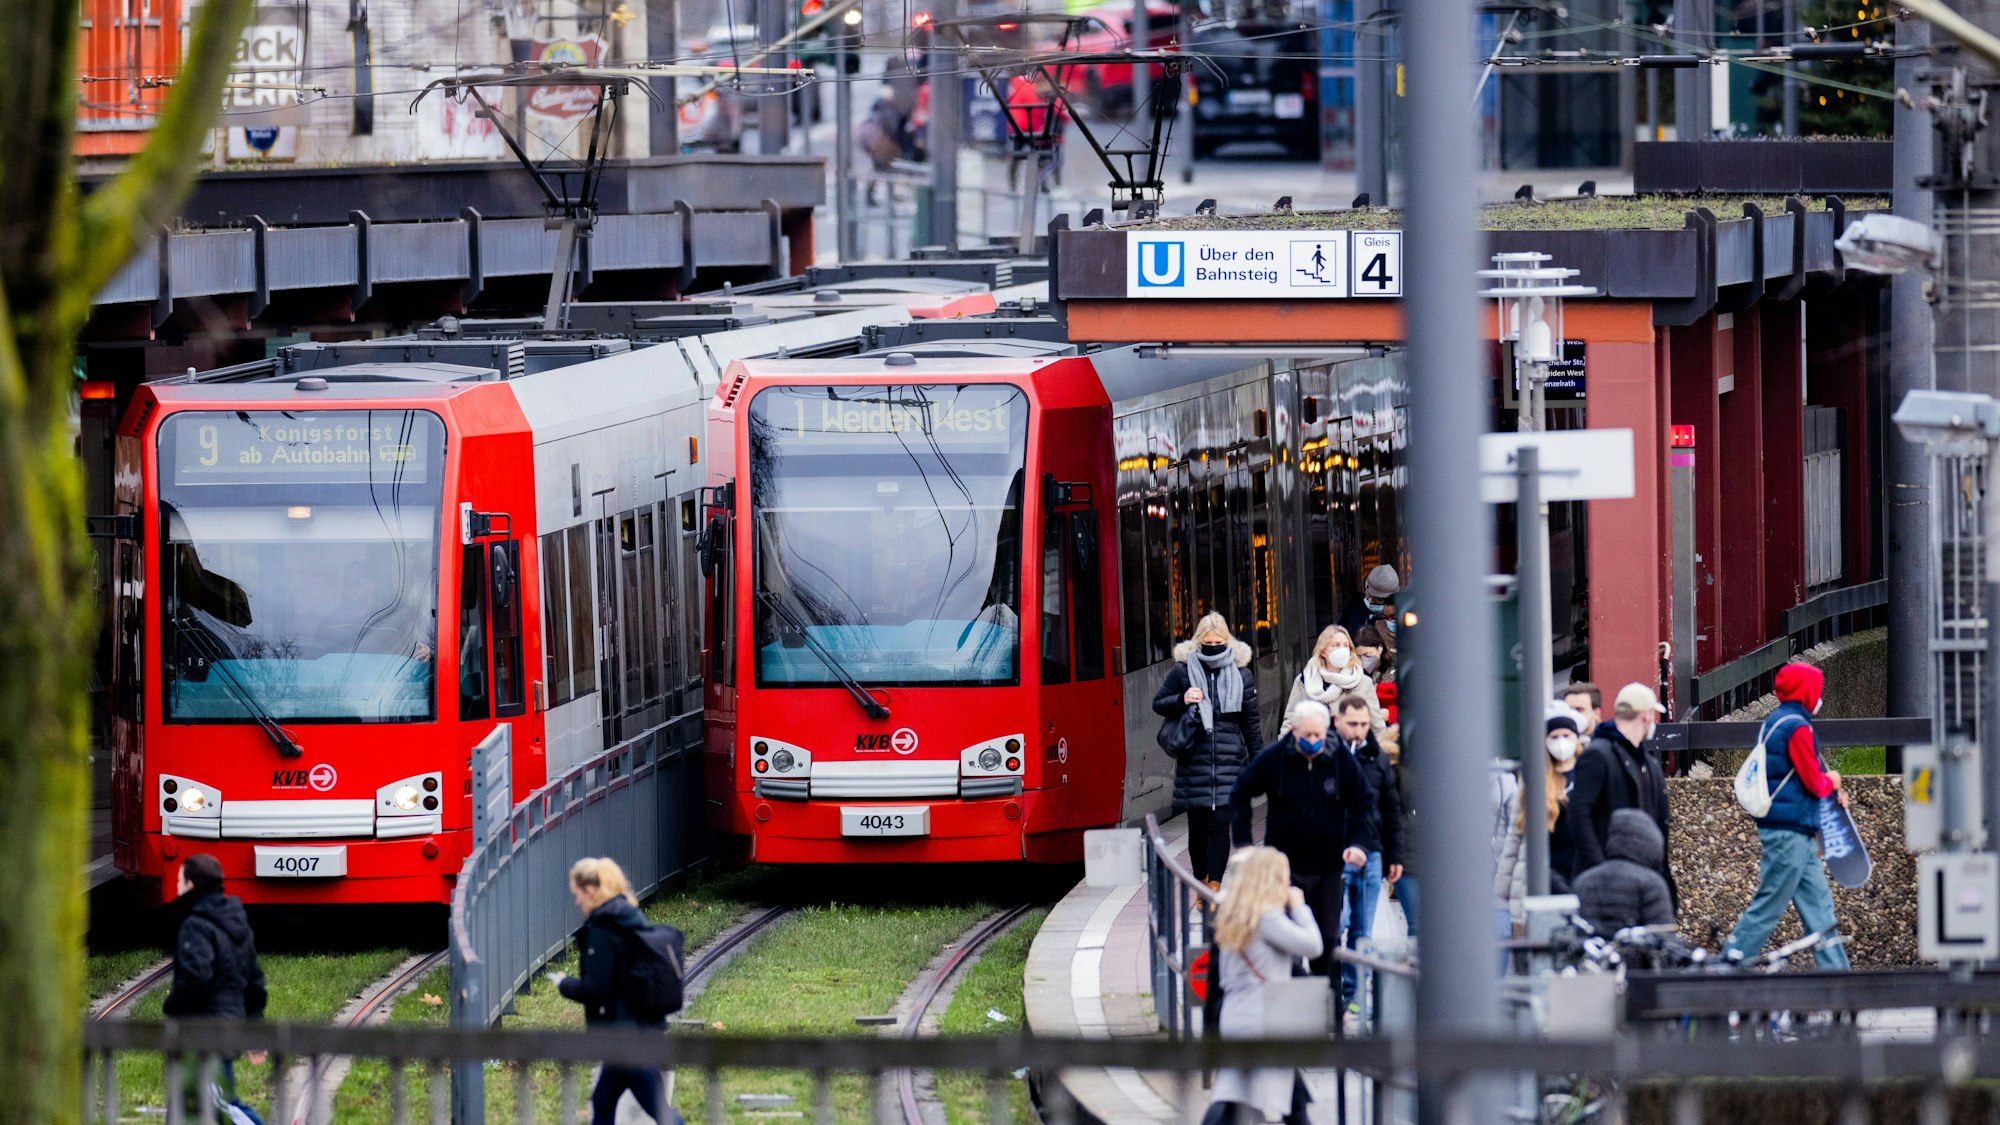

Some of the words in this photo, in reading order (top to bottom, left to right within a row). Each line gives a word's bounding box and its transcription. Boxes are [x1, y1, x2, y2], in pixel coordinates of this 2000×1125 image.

[235, 31, 295, 62] ack
[1364, 236, 1391, 247] Gleis
[1200, 244, 1238, 261] Über
[1245, 247, 1274, 261] den
[1196, 267, 1278, 283] Bahnsteig
[1361, 253, 1393, 290] 4
[1546, 369, 1566, 377] eiden
[1566, 369, 1585, 377] West
[1544, 380, 1576, 388] enzelrath
[821, 399, 923, 433] Weiden
[932, 399, 1006, 433] West
[199, 425, 218, 466] 9
[259, 424, 393, 443] Königsforst
[238, 446, 262, 465] ab
[270, 445, 371, 465] Autobahn
[856, 734, 891, 749] KVB
[272, 770, 309, 786] KVB
[860, 815, 905, 829] 4043
[273, 857, 320, 872] 4007
